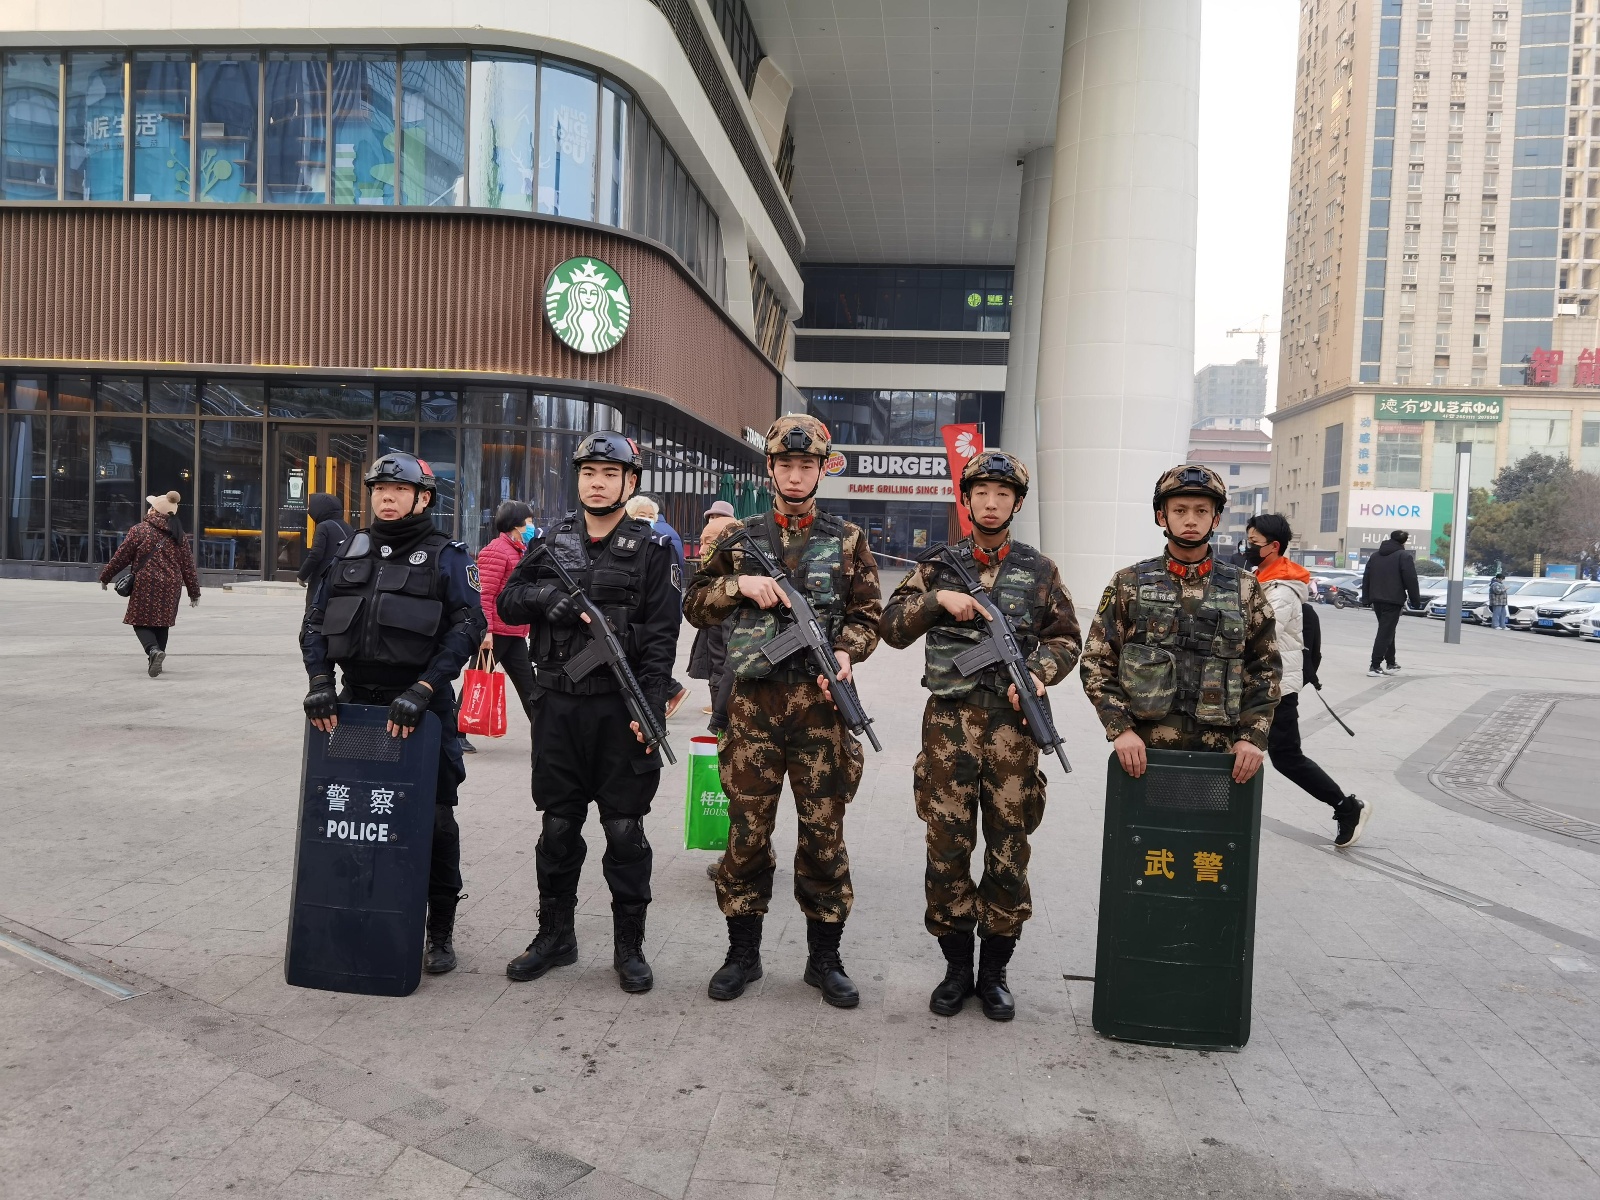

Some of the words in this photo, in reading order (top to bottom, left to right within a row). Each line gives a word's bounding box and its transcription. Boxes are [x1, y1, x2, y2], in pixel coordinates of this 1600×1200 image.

[858, 455, 947, 476] BURGER
[849, 484, 875, 493] FLAME
[877, 485, 914, 494] GRILLING
[916, 486, 939, 495] SINCE
[941, 487, 954, 495] 19
[1360, 504, 1420, 517] HONOR
[1362, 533, 1416, 545] HUAEI
[326, 784, 395, 815] 警察
[327, 820, 389, 842] POLICE
[1144, 848, 1223, 883] 武警
